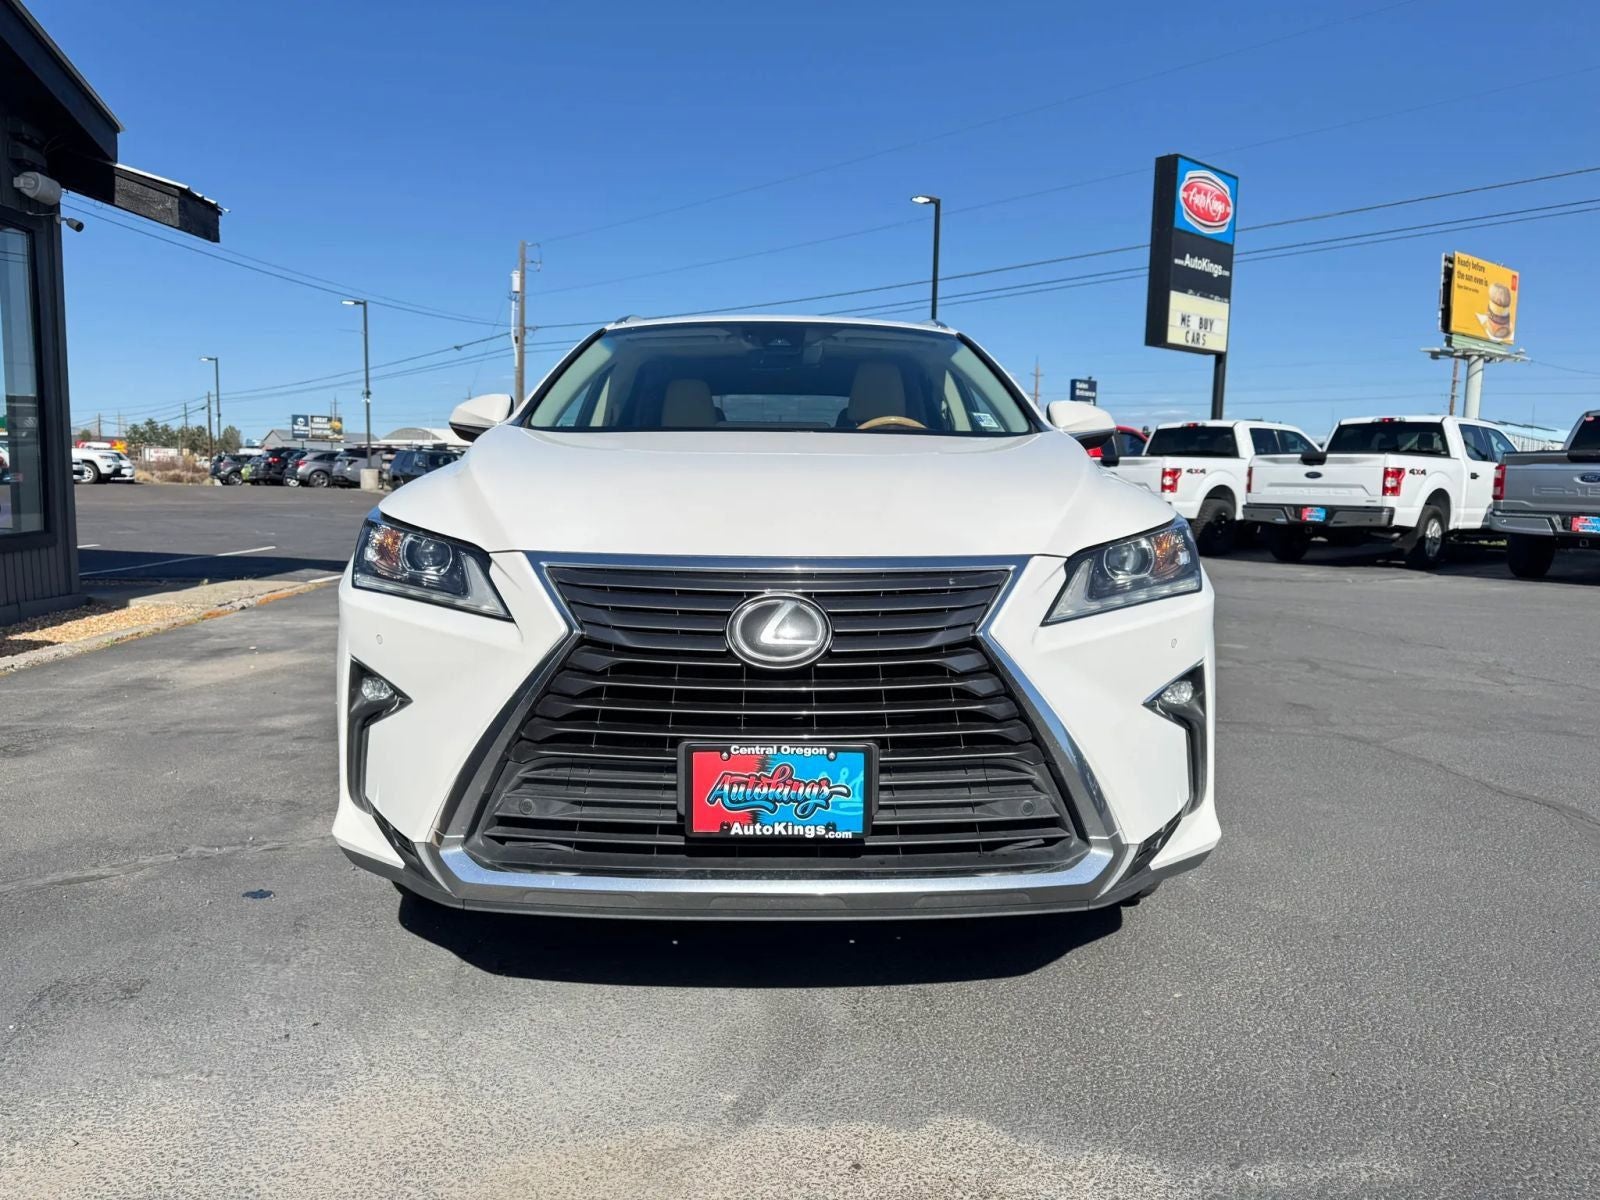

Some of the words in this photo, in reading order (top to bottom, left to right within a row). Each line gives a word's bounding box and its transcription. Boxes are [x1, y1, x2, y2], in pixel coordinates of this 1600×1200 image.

[1180, 312, 1191, 328] WE
[1199, 316, 1215, 332] BUY
[1185, 330, 1207, 347] CARS
[730, 745, 777, 755] Central
[781, 745, 827, 757] Oregon
[730, 822, 853, 839] AutoKings.com
